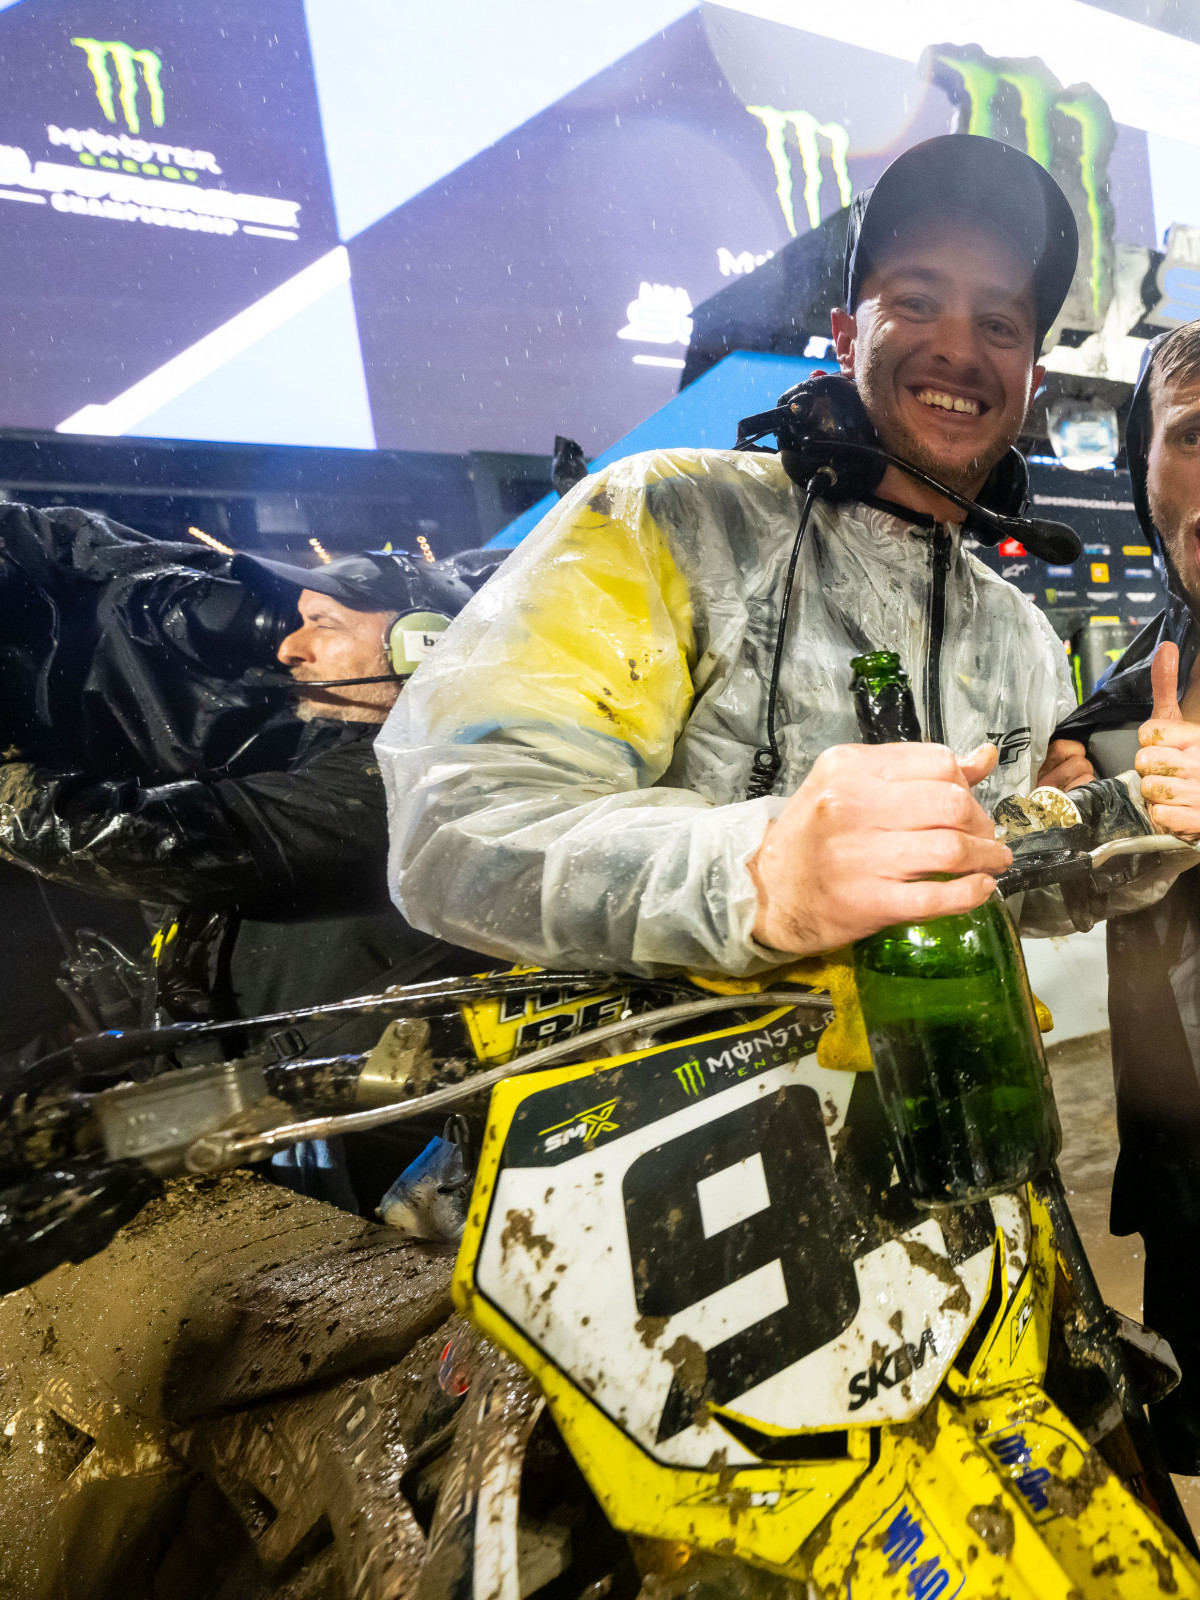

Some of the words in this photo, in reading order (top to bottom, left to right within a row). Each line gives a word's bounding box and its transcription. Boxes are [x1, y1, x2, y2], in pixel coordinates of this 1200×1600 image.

[47, 124, 222, 174] MONSTER
[737, 1040, 815, 1077] ENERG
[541, 1098, 620, 1153] SMX
